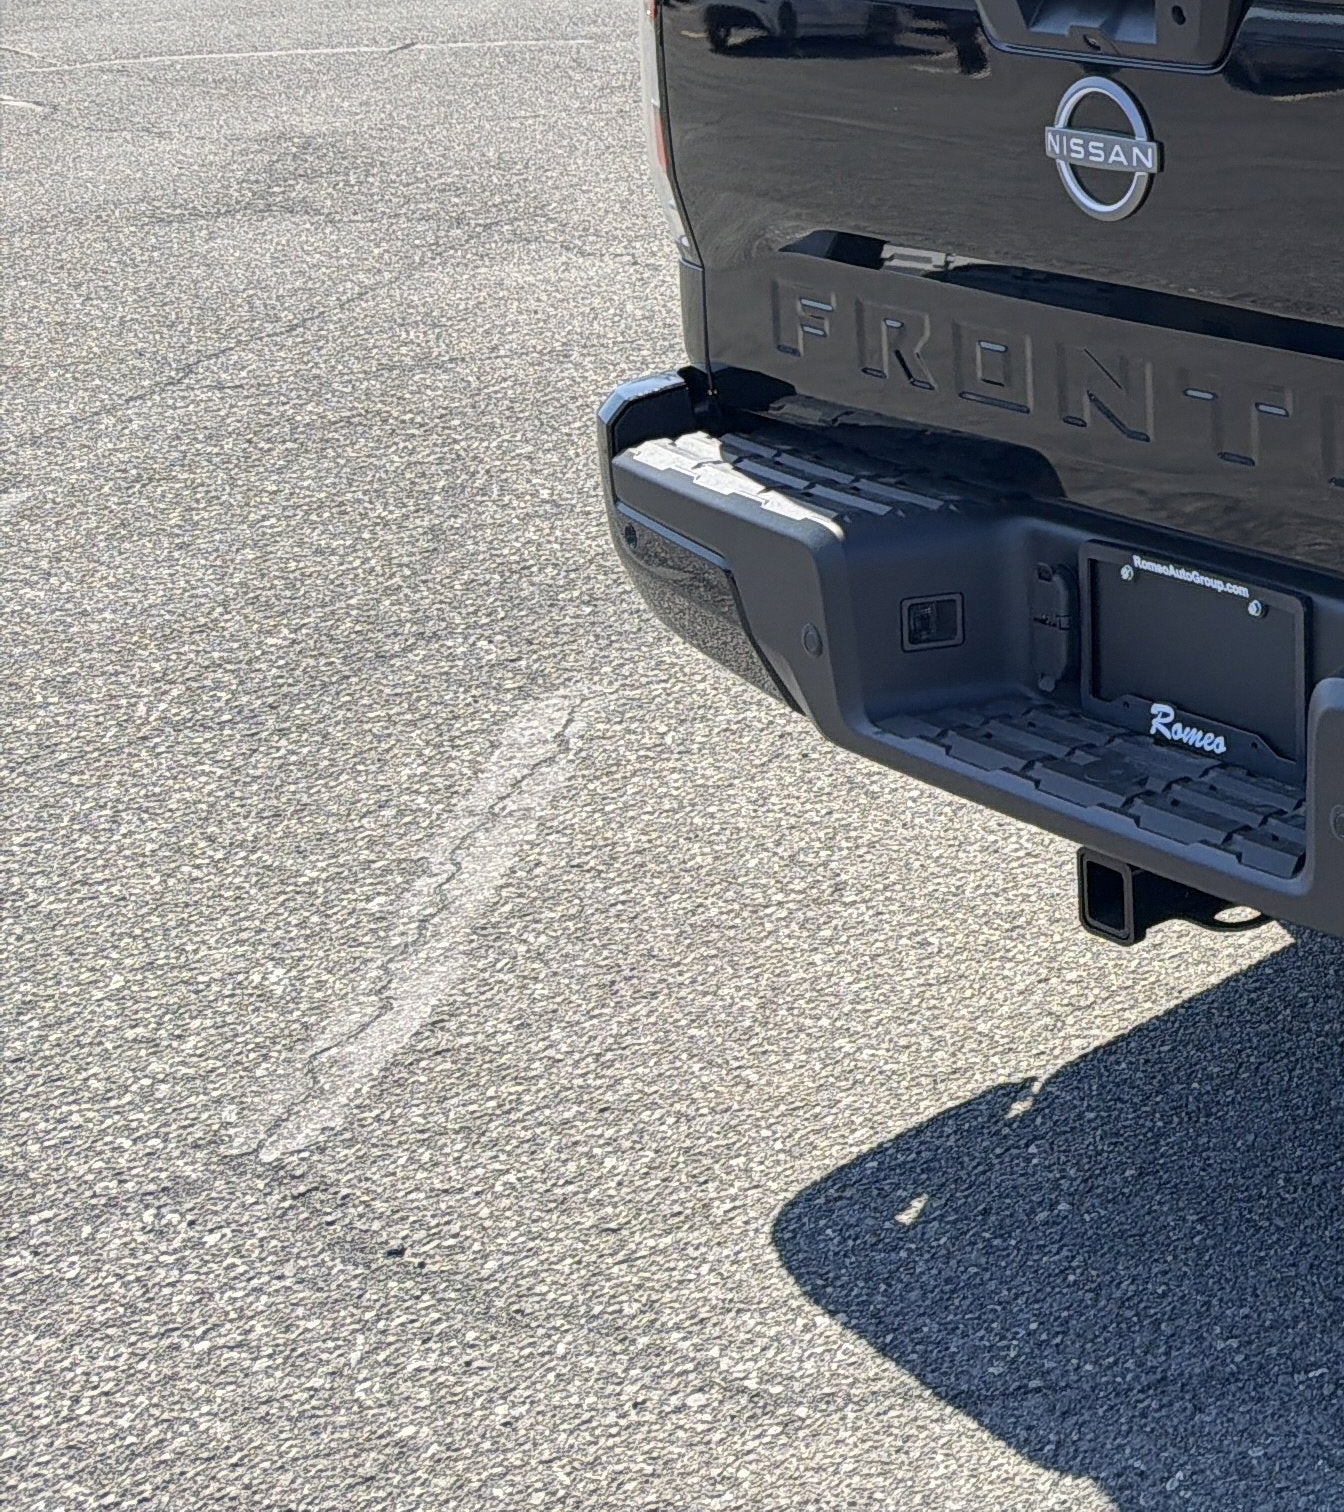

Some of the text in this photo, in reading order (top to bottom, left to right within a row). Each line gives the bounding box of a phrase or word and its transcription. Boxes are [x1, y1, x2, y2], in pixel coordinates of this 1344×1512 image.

[1046, 129, 1155, 171] NISSAN
[1132, 554, 1250, 599] RomeoAutoGroup.com
[1149, 702, 1227, 755] Romeo
